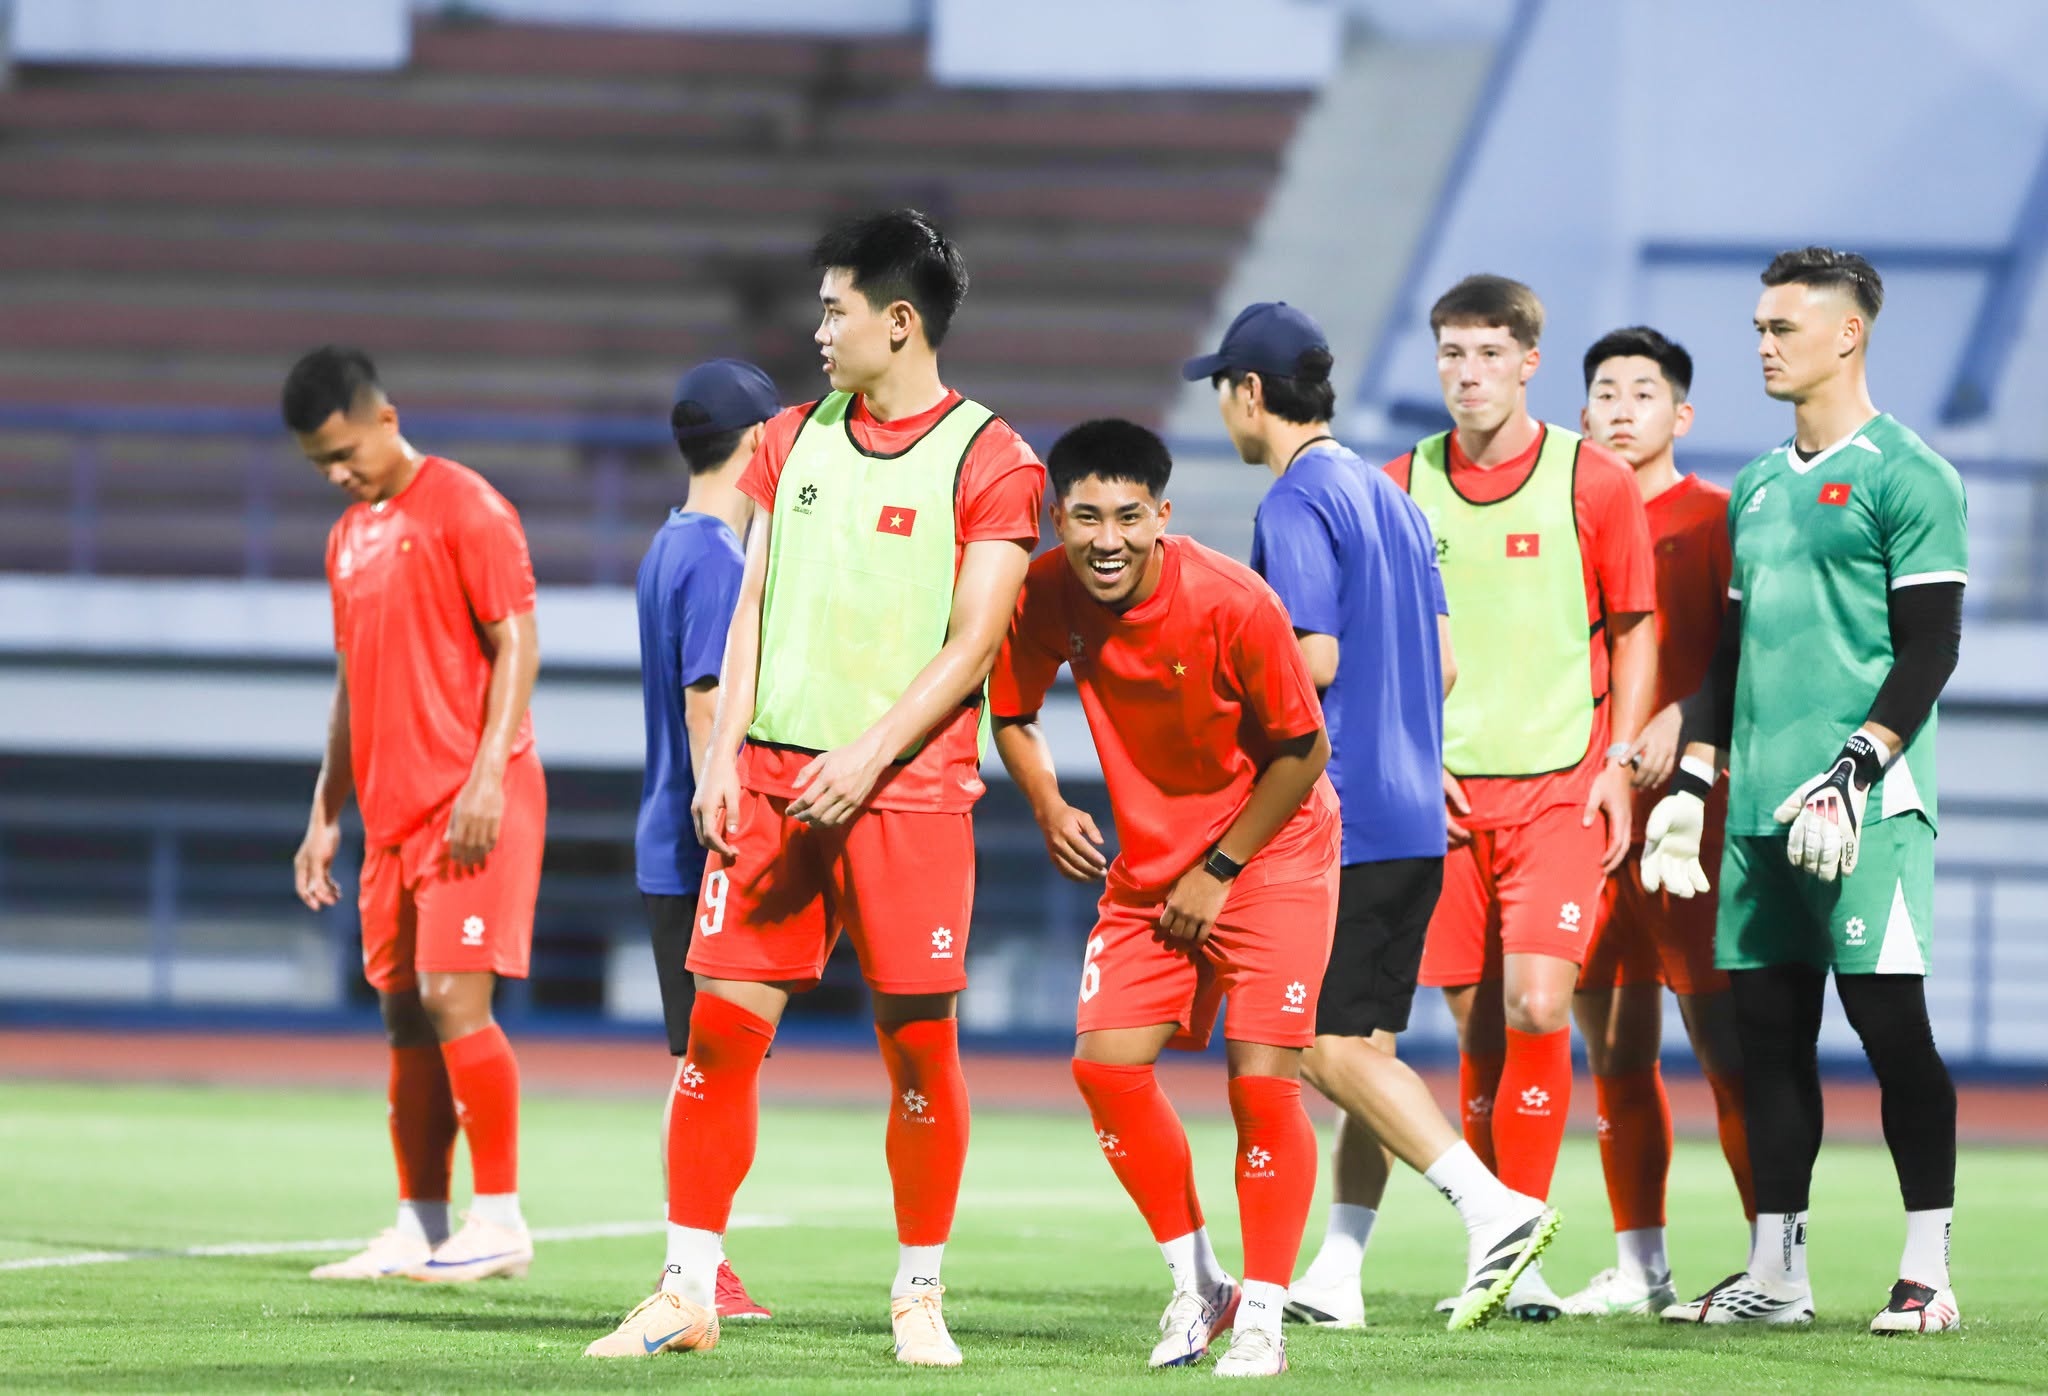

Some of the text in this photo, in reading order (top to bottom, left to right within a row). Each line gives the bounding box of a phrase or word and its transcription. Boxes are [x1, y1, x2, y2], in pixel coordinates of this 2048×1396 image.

[1845, 841, 1854, 867] PRED
[700, 869, 730, 937] 9
[1081, 935, 1105, 1004] 6
